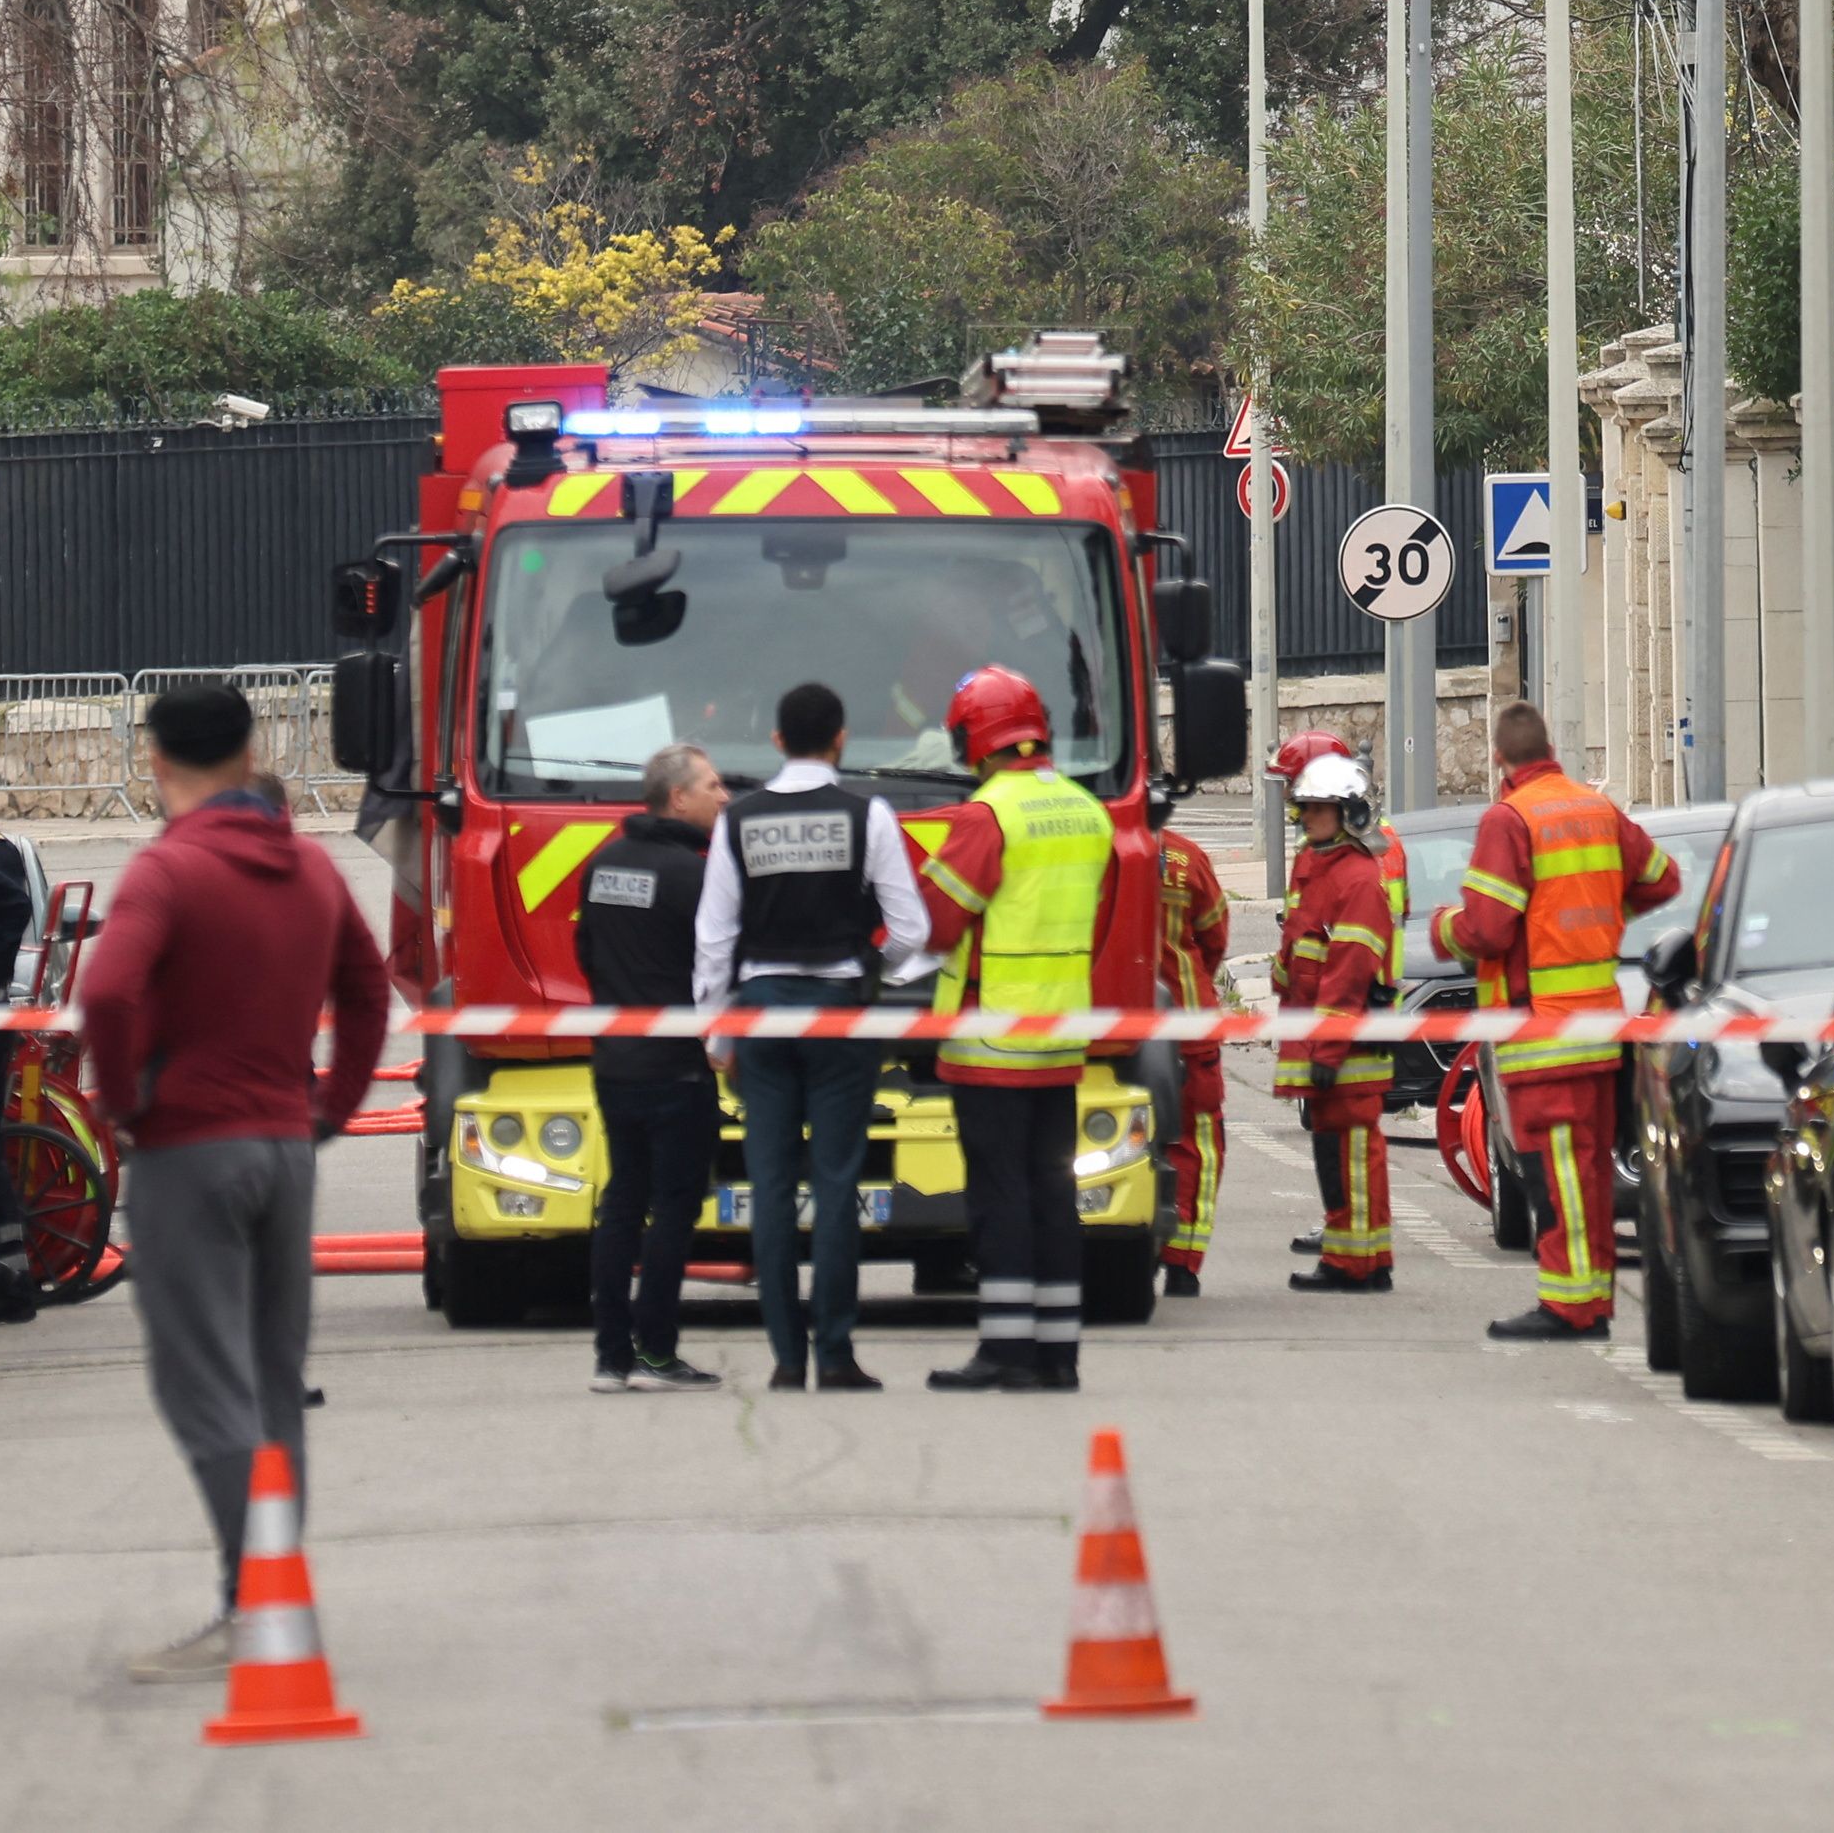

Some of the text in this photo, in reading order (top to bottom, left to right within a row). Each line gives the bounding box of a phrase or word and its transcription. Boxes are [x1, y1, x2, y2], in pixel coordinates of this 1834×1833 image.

[1363, 542, 1430, 586] 30
[744, 822, 846, 850] POLICE
[749, 849, 848, 869] JUDICIAIRE
[597, 873, 650, 895] POLICE
